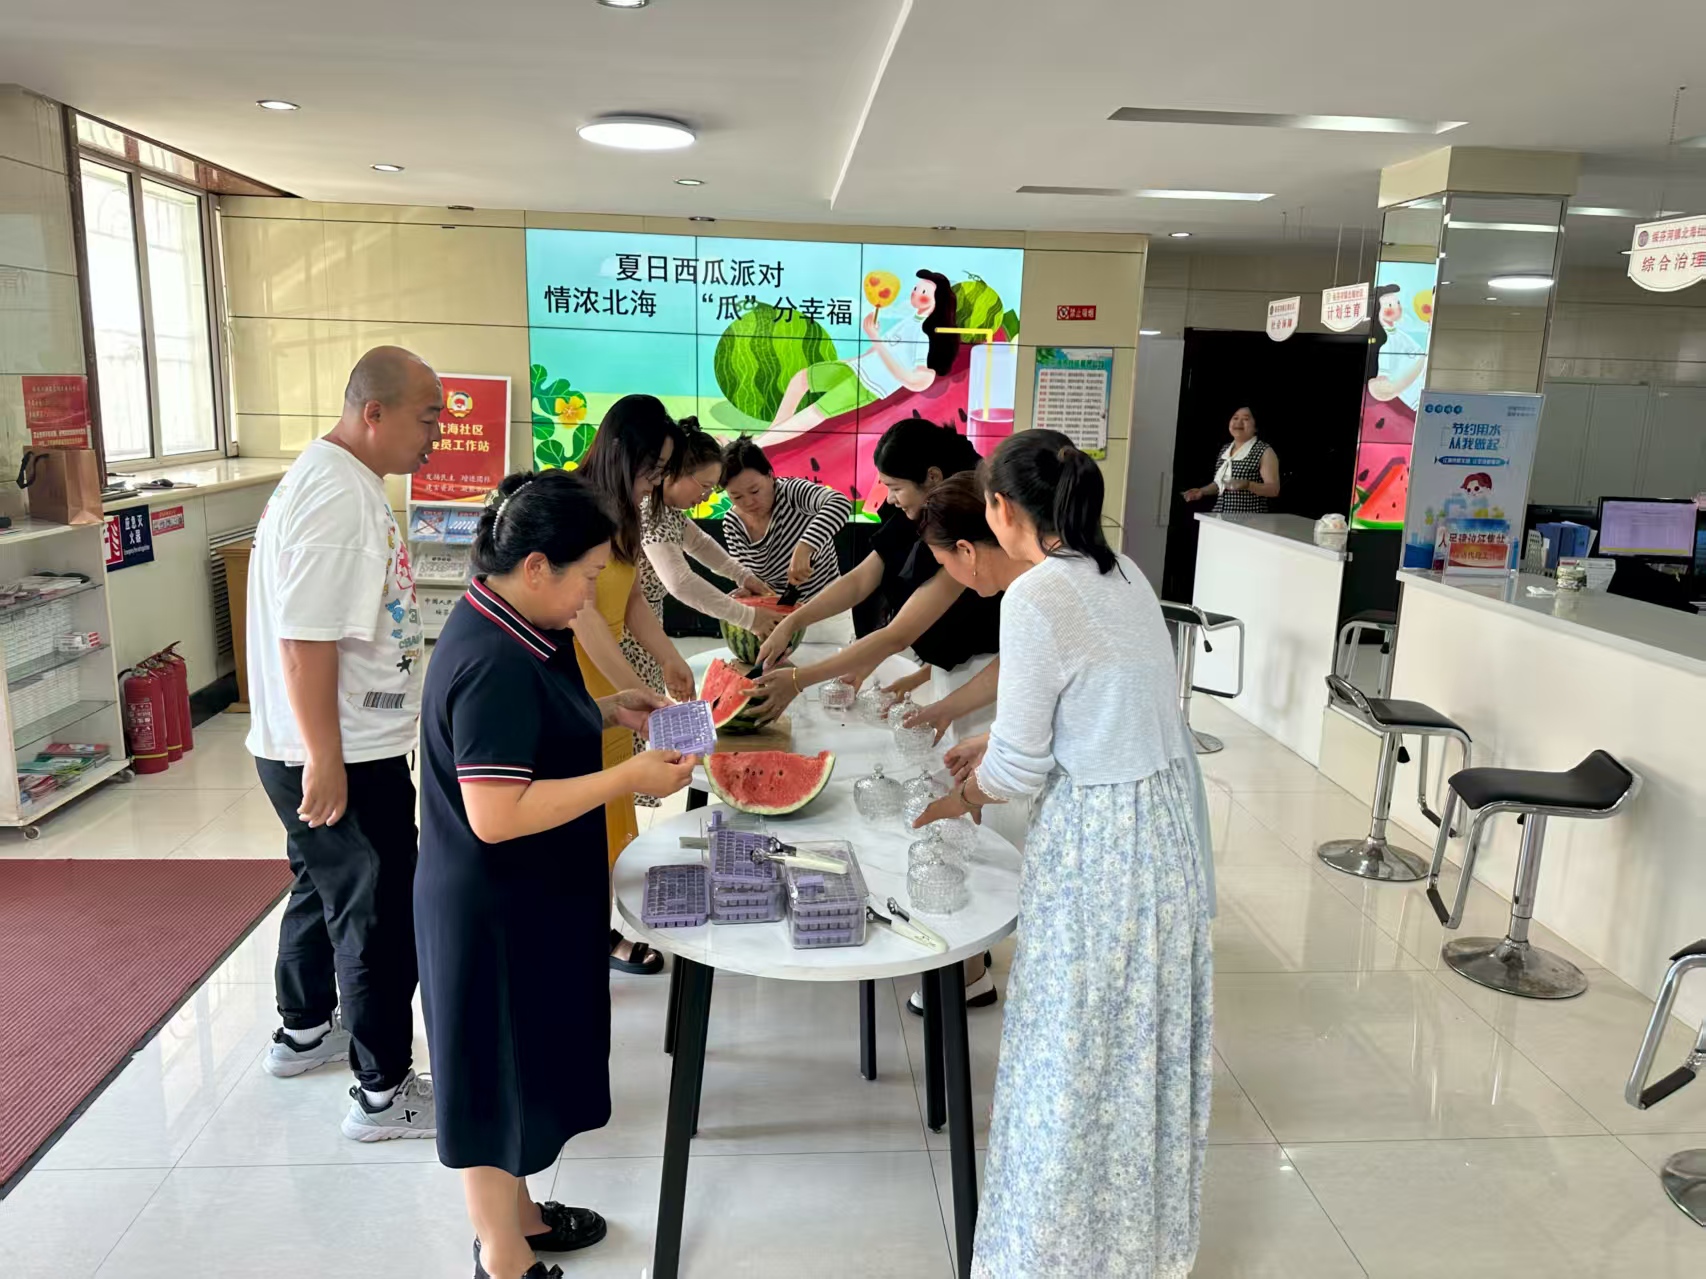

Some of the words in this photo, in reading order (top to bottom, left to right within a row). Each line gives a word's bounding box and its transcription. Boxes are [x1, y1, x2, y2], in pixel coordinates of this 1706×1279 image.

[1641, 251, 1706, 272] 综合治理
[615, 252, 785, 289] 夏日西瓜派对
[544, 284, 657, 318] 情浓北海
[1327, 303, 1361, 320] 计划生育
[1271, 318, 1293, 330] 社会保障
[1452, 422, 1502, 436] 节约用水
[1449, 437, 1500, 450] 从我做起
[125, 514, 143, 530] 应急灭
[129, 529, 141, 544] 火器
